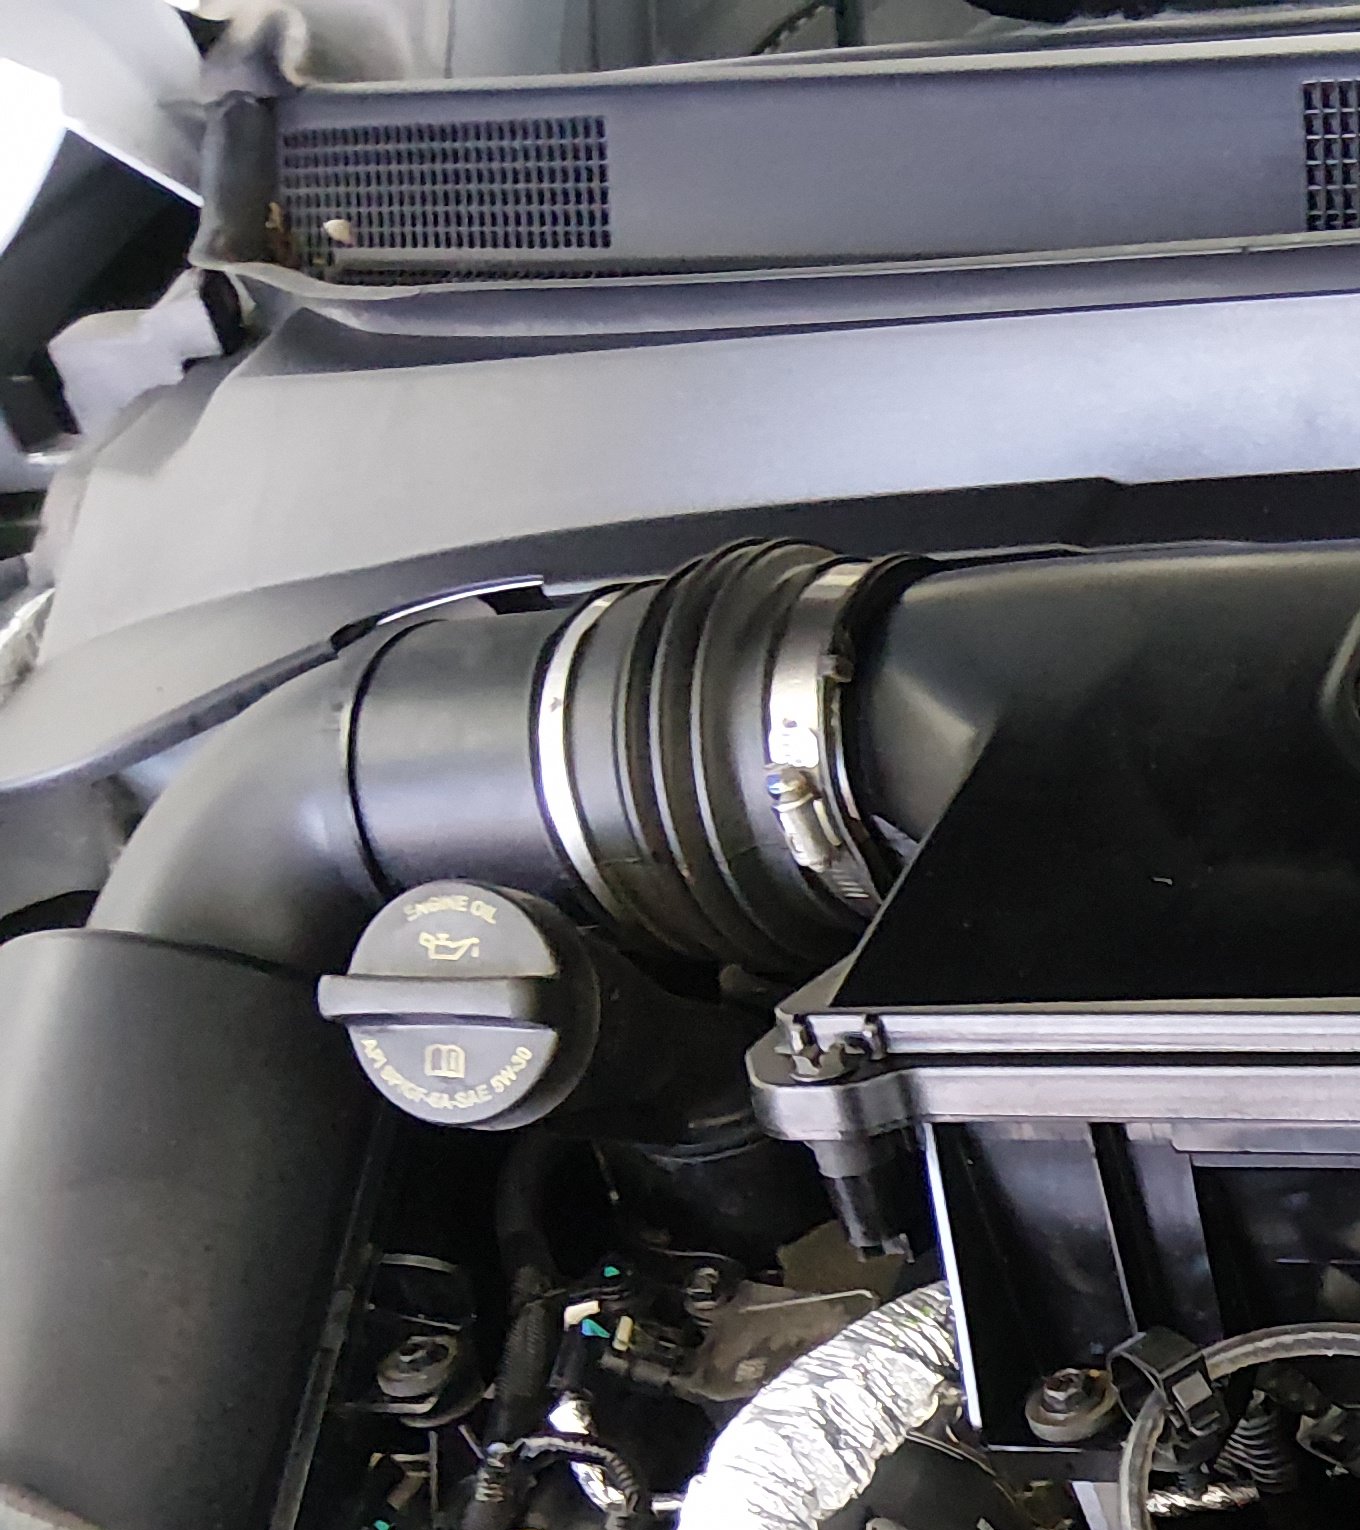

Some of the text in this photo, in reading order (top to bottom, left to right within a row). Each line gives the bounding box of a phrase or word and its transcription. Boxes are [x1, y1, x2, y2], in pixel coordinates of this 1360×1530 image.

[404, 895, 498, 925] ENGINE OIL
[360, 1039, 388, 1070] API
